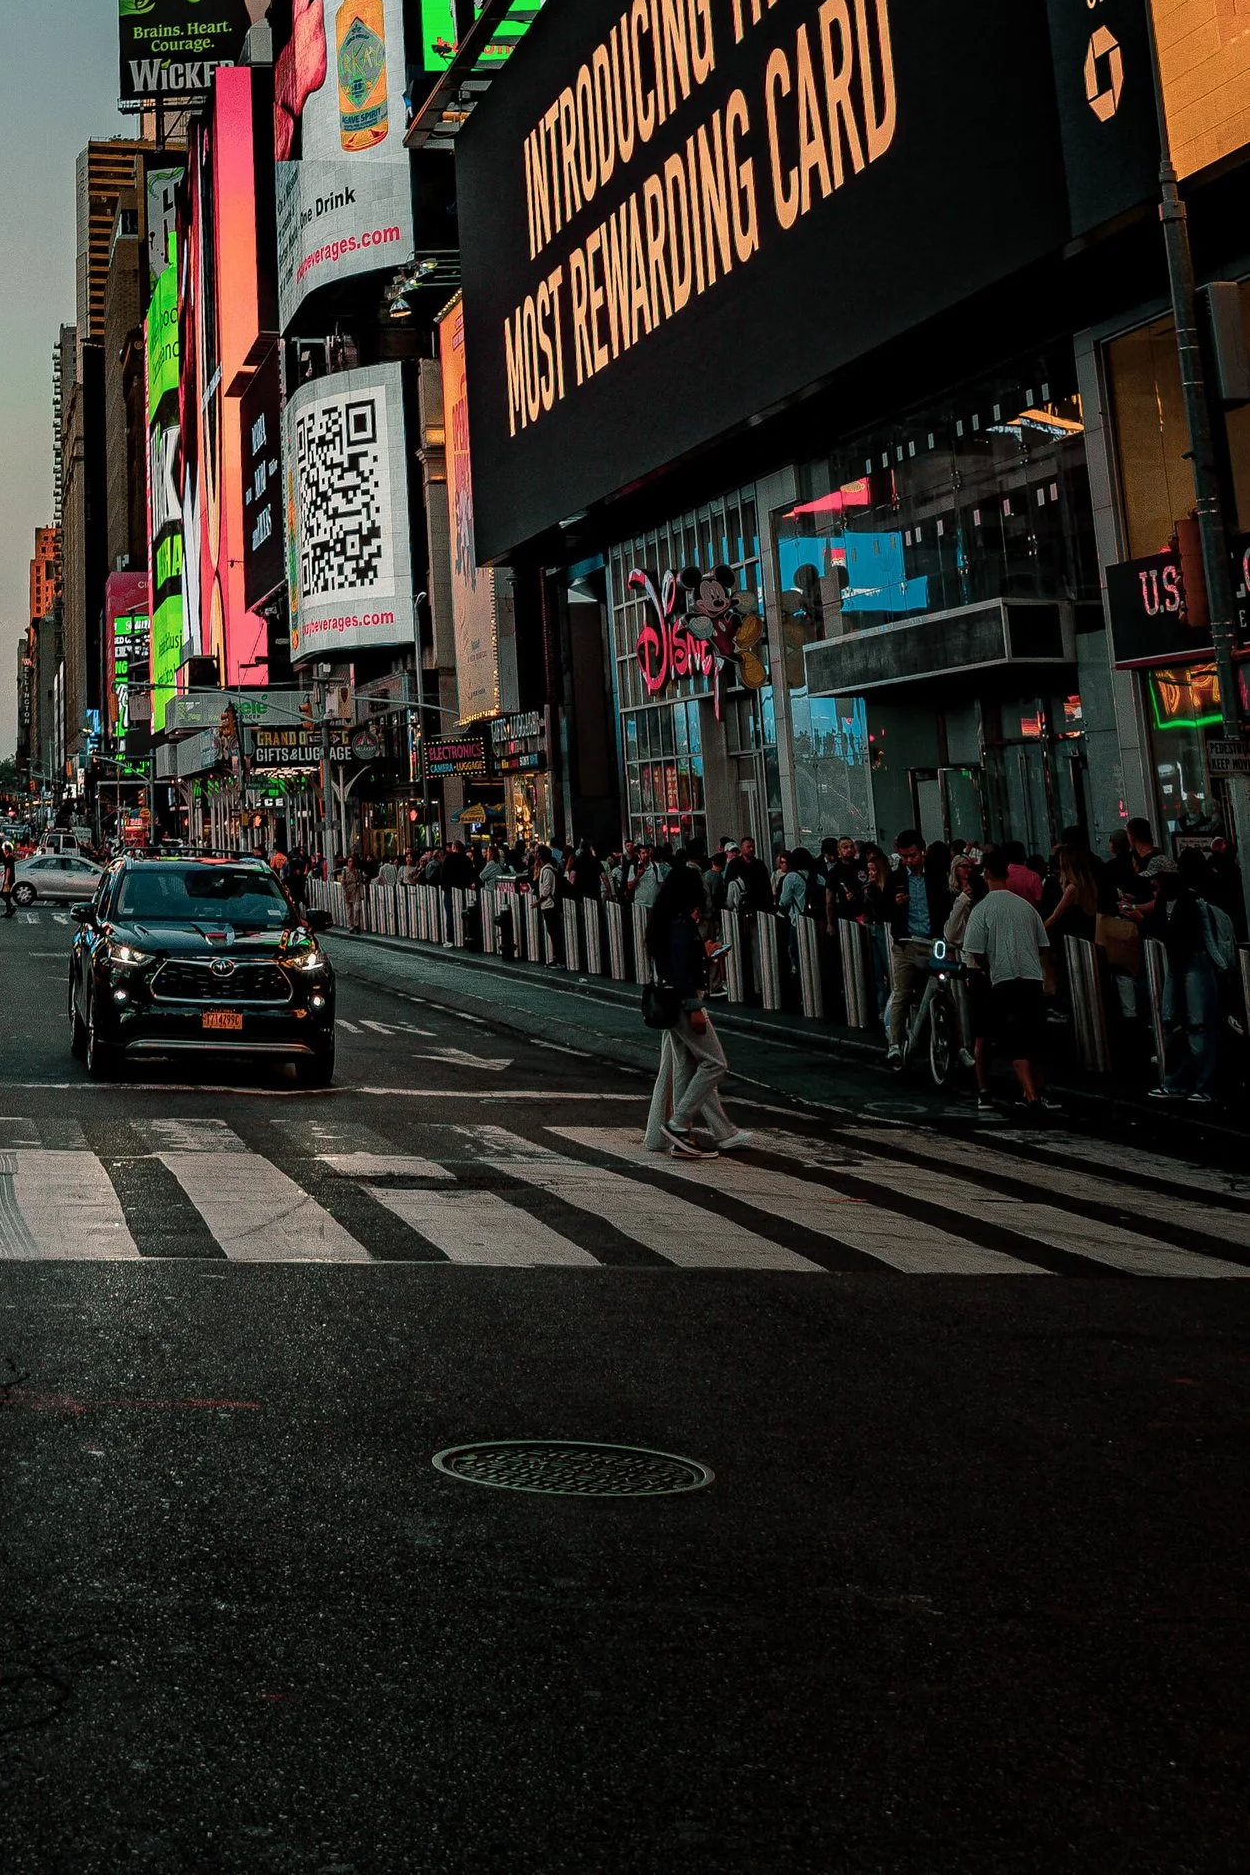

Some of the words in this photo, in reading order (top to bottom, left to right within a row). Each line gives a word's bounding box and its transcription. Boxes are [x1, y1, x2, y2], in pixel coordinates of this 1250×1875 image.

[133, 23, 185, 40] Brains.
[187, 20, 233, 37] Heart.
[150, 37, 216, 53] Courage.
[360, 106, 382, 122] SPIRIT
[315, 186, 356, 218] Drink
[502, 263, 566, 439] MOST
[568, 87, 761, 387] REWARDING
[256, 731, 297, 747] GRAND
[255, 746, 352, 762] GIFTS&LUGAGE
[428, 743, 482, 761] ELECTRONICS
[430, 763, 454, 774] CAMERA
[455, 760, 484, 772] LUGGAGE
[1211, 757, 1231, 770] KEEP
